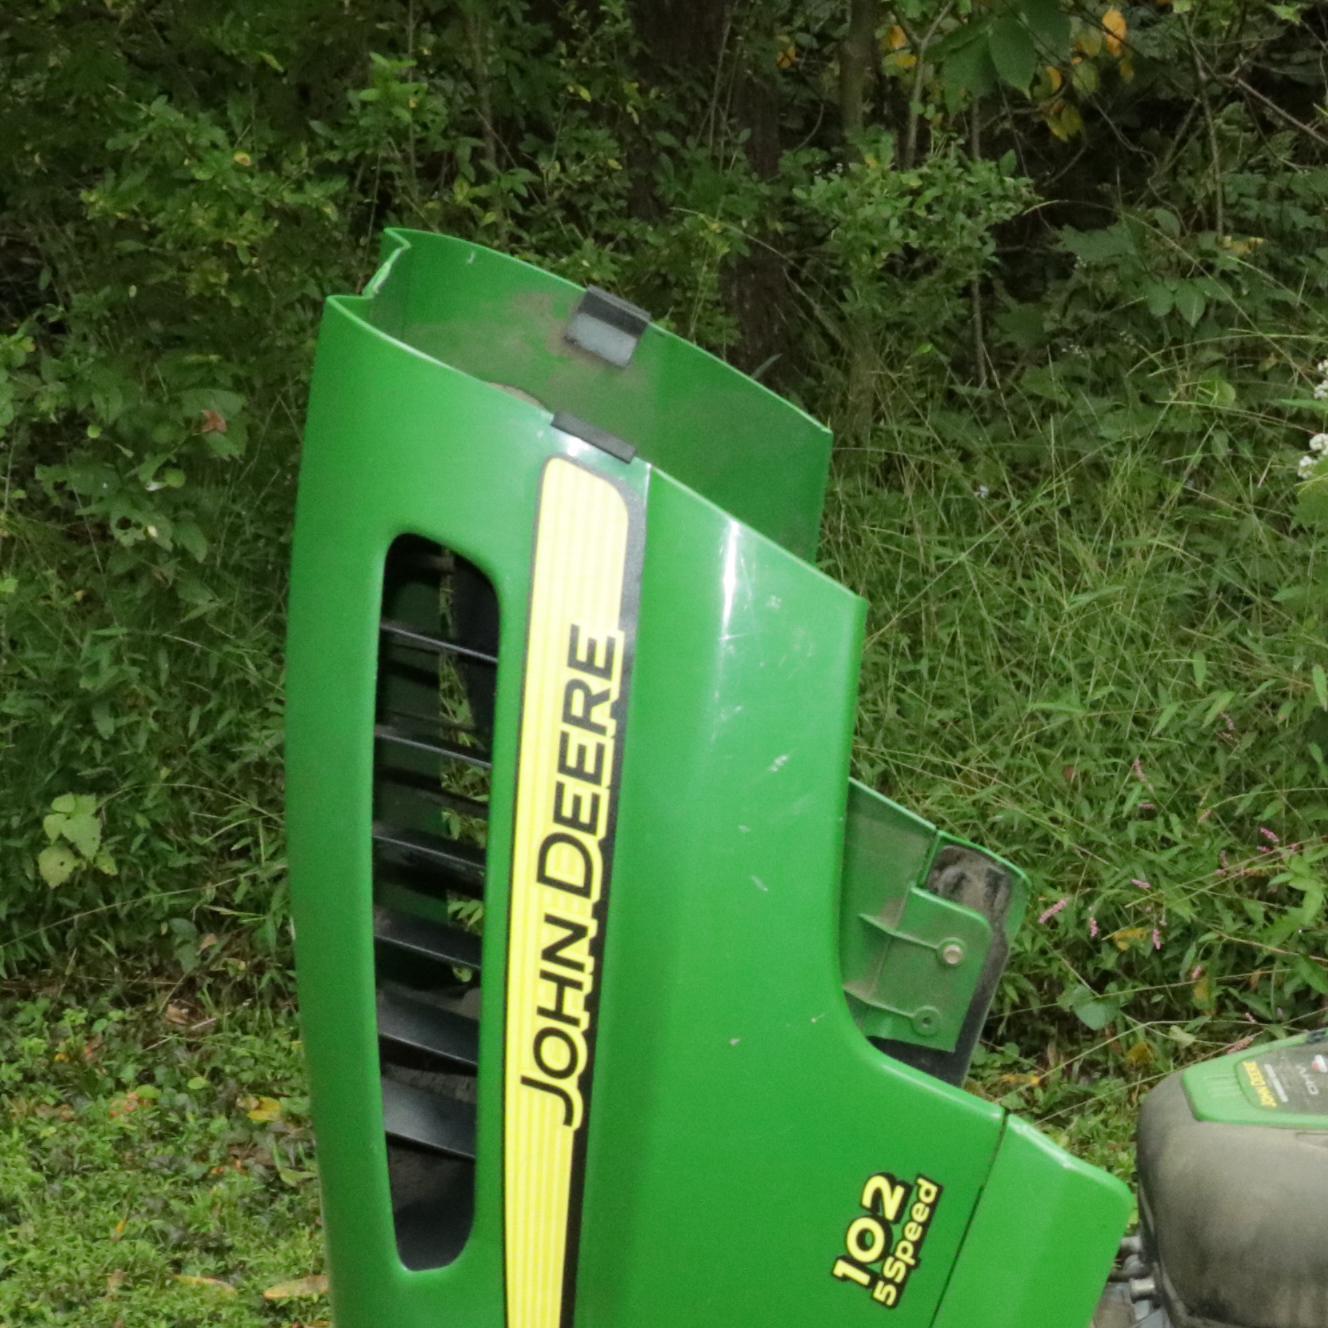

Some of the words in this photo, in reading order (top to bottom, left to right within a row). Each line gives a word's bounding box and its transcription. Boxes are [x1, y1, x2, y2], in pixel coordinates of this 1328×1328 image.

[536, 624, 615, 900] DEERE
[520, 913, 588, 1127] JOHN
[832, 1173, 908, 1288] 102
